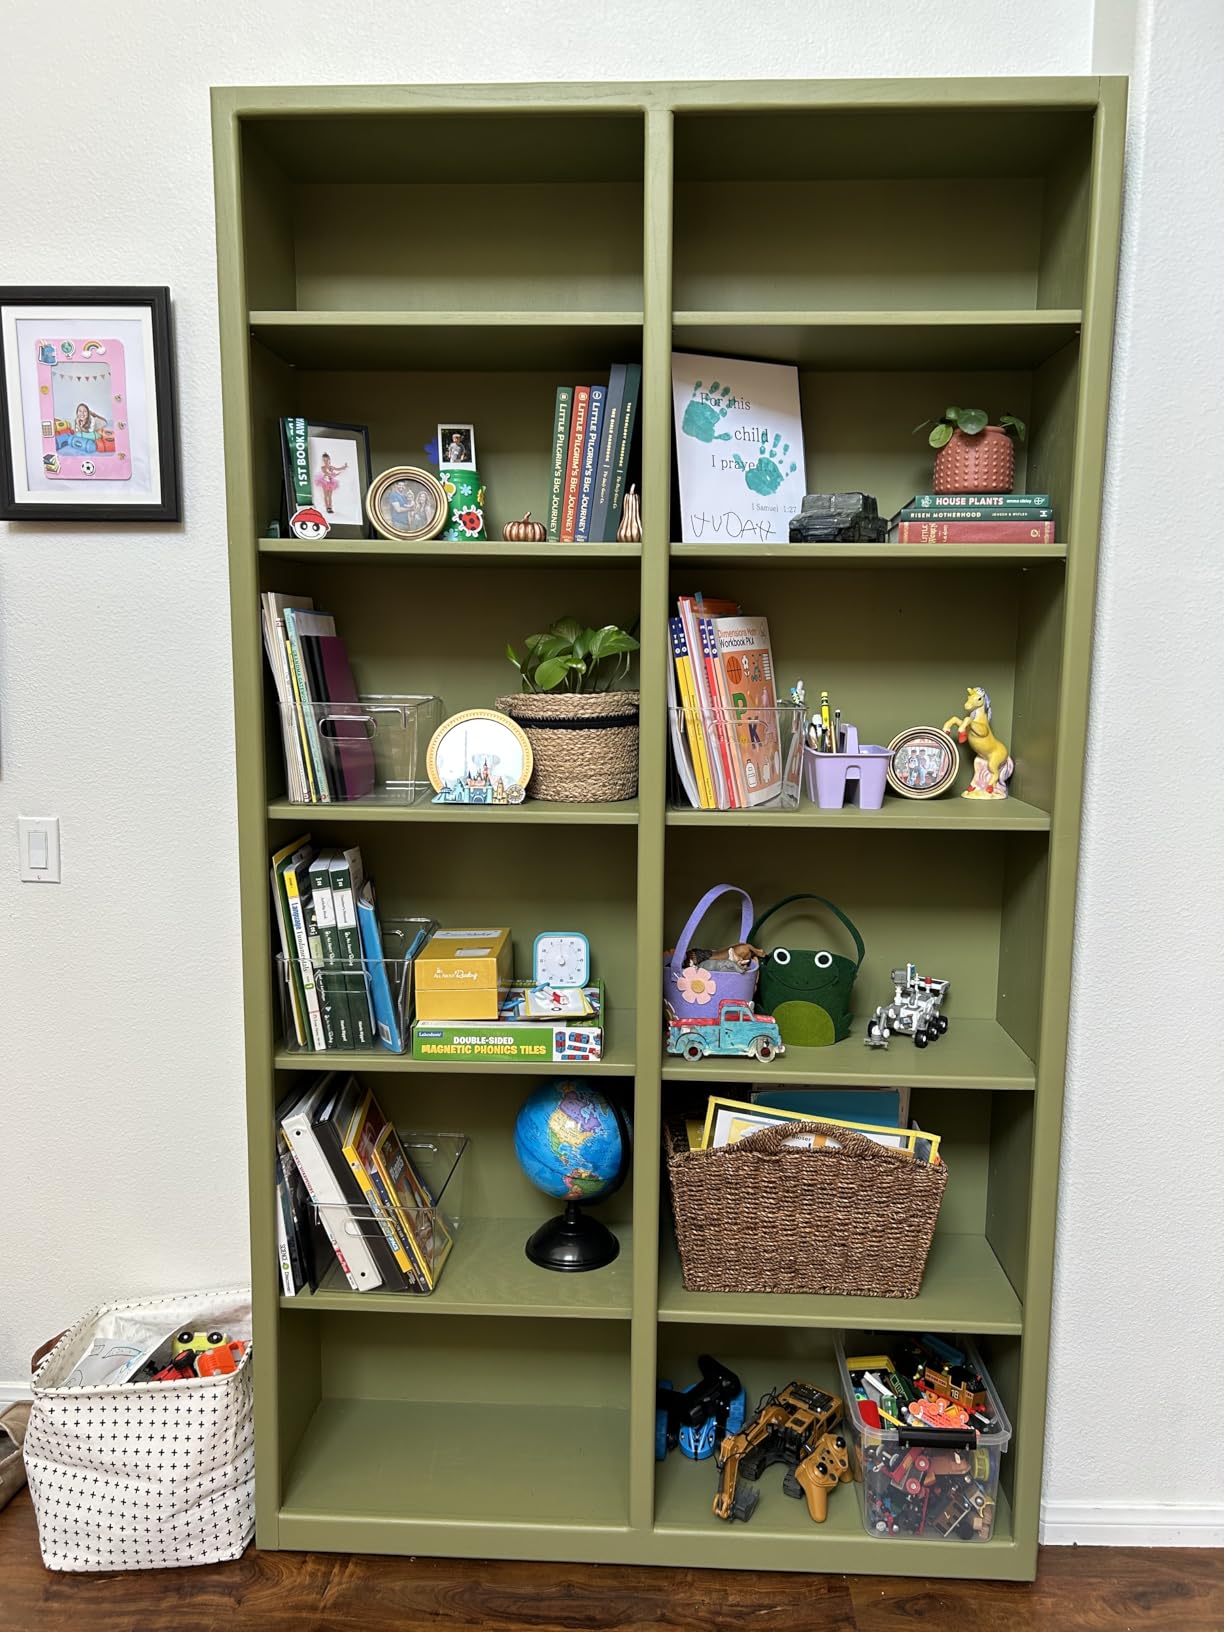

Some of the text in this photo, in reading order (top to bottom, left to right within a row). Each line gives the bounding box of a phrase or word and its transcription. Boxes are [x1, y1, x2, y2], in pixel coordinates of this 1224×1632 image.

[700, 393, 751, 411] For this
[557, 403, 567, 432] LITTLE
[575, 402, 586, 432] LITTLE
[588, 402, 601, 432] LITTLE
[734, 426, 769, 443] child
[296, 436, 307, 466] BOOK
[554, 434, 565, 476] PILGRIM'S
[571, 433, 583, 476] PILGRIM'S
[584, 433, 597, 476] PILGRIM'S
[711, 455, 717, 467] I
[298, 467, 308, 487] 1ST
[552, 478, 561, 493] BIG
[569, 477, 578, 493] BIG
[583, 477, 592, 493] BIG
[757, 503, 779, 513] Samuel
[936, 497, 966, 506] HOUSE
[968, 496, 1004, 505] PLANTS
[550, 494, 560, 534] JOURNEY
[565, 494, 576, 533] JOURNEY
[578, 494, 590, 533] JOURNEY
[932, 511, 982, 519] MOTHERHOOD
[717, 628, 747, 638] Dimensions
[719, 638, 746, 648] Workbook
[291, 902, 308, 972] Language Fundamentals
[453, 1036, 514, 1045] DOUBLE-SIDED
[421, 1045, 547, 1055] MAGNETIC PHONICS TILES
